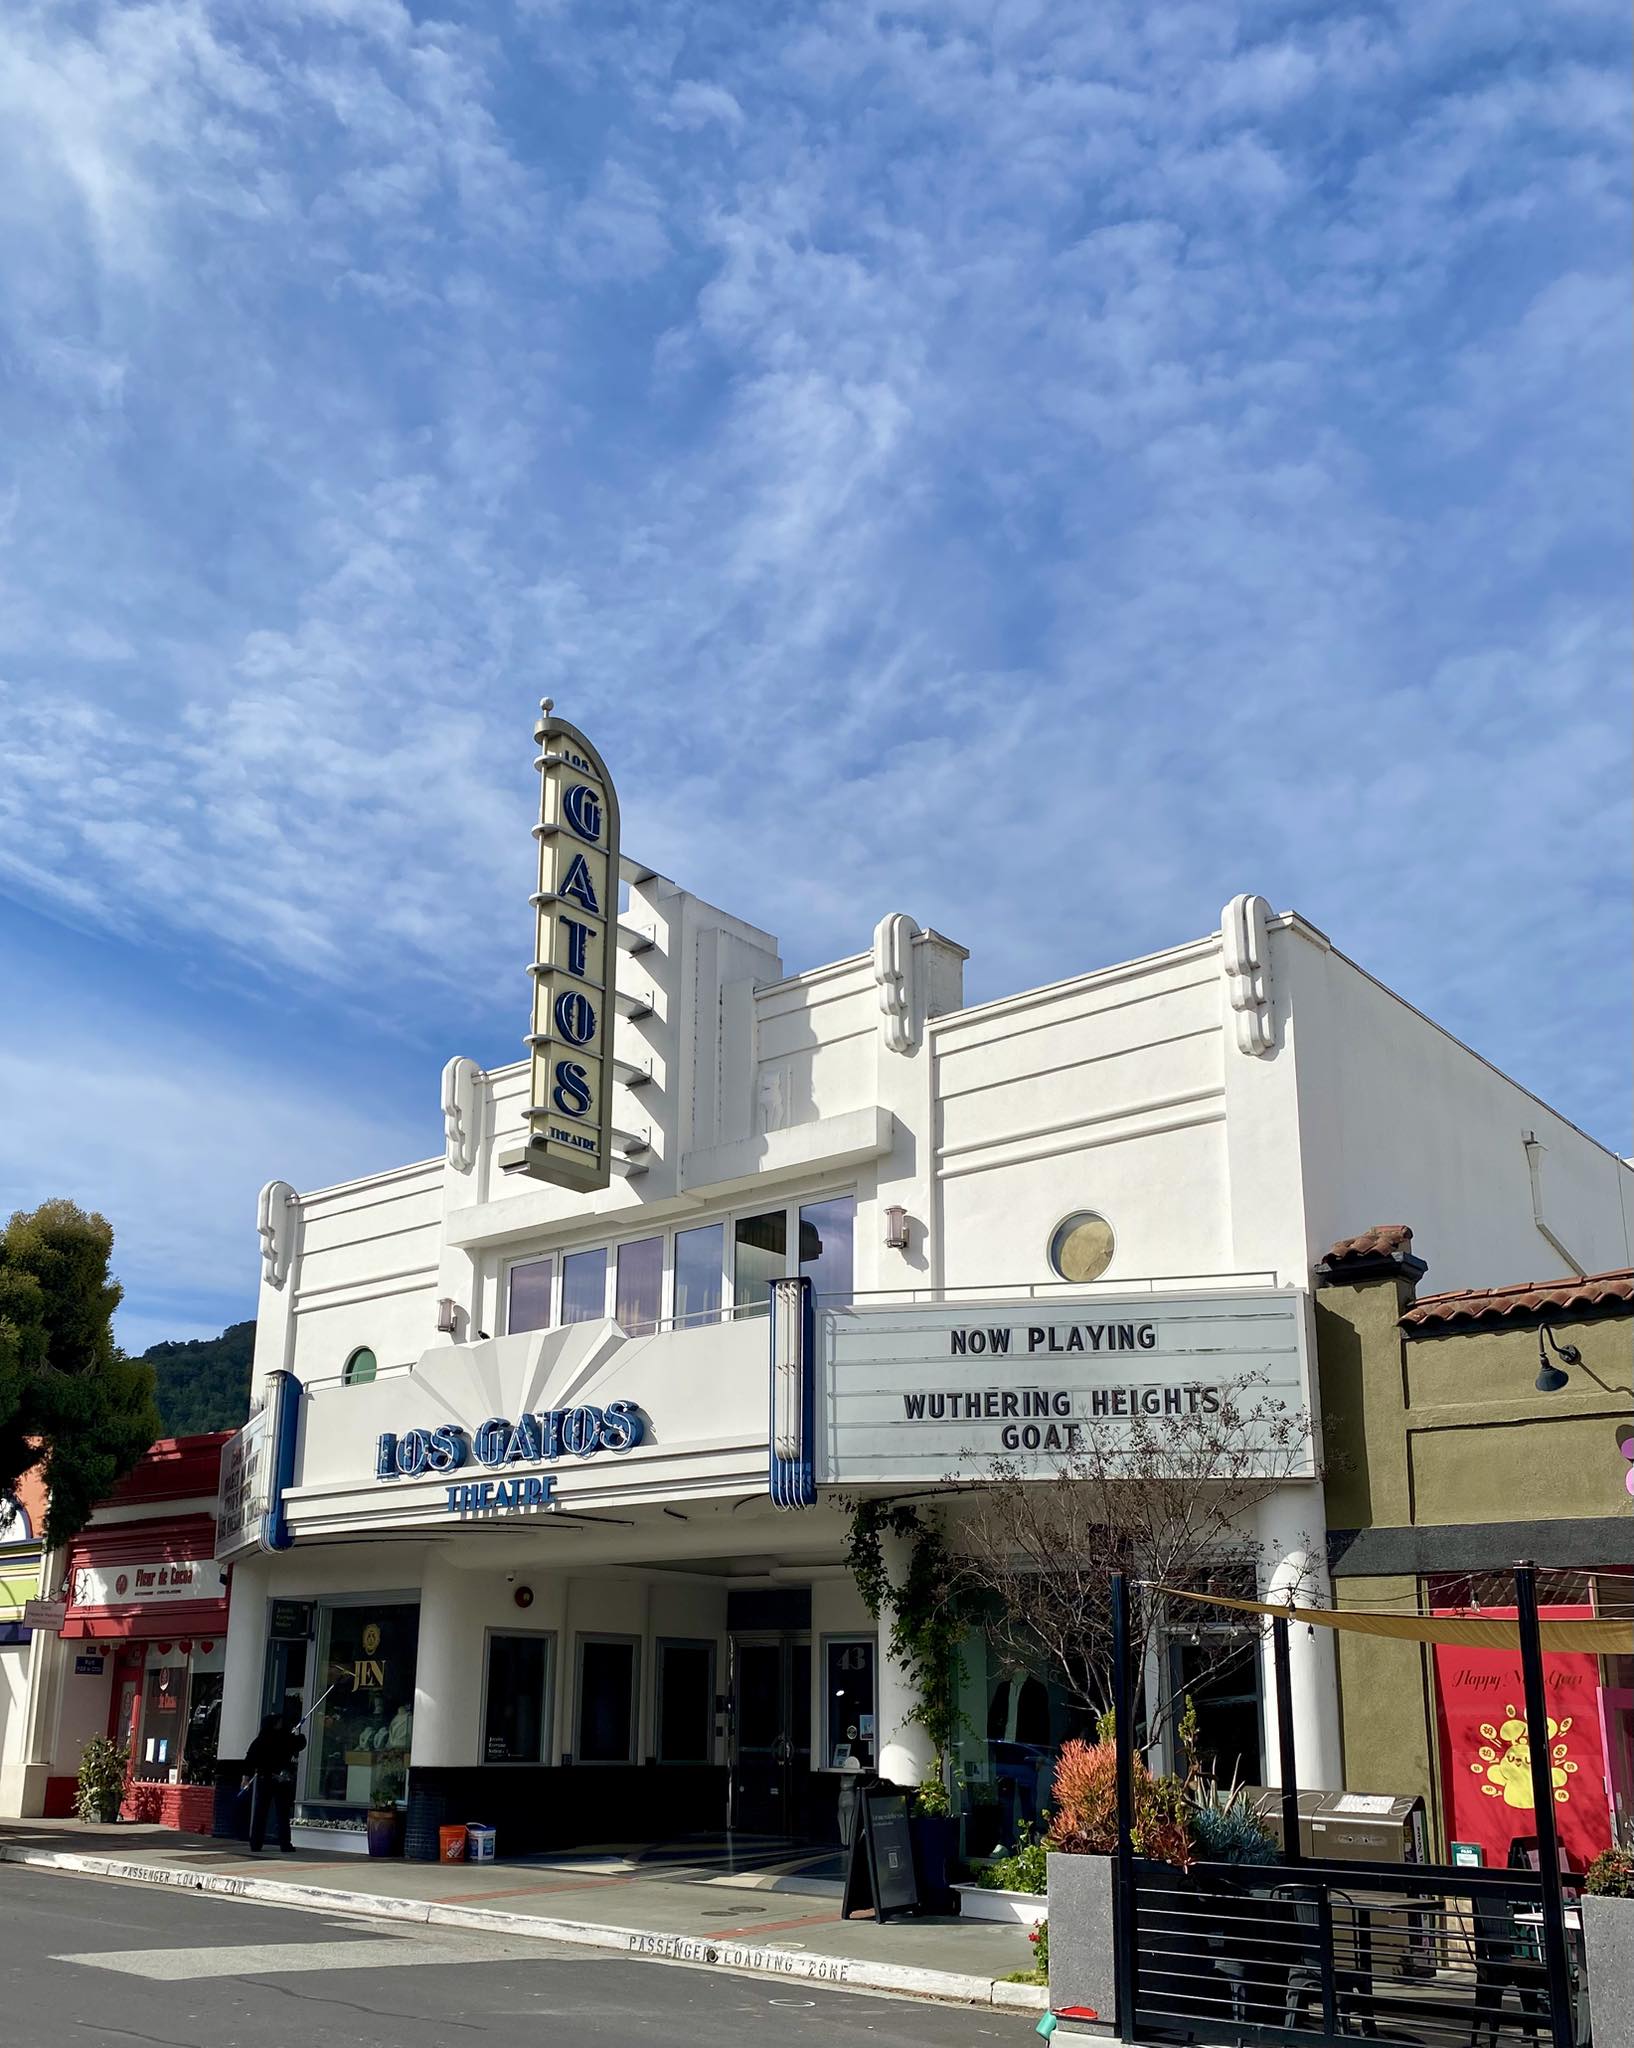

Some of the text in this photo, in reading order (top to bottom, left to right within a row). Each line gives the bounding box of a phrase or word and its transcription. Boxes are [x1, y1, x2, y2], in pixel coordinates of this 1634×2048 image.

[554, 784, 601, 1118] GATOS
[548, 1126, 597, 1152] THEATRE
[950, 1323, 1157, 1355] NOW PLAYING
[904, 1385, 1221, 1420] WUTHERING HEIGHTS
[375, 1400, 645, 1482] LOS GATOS
[1001, 1422, 1080, 1451] GOAT
[445, 1474, 558, 1513] THEATRE
[135, 1566, 193, 1588] Fleur de Cocoa
[838, 1646, 866, 1671] 43
[351, 1660, 387, 1693] JEN
[1452, 1669, 1501, 1692] Happy
[122, 1866, 171, 1883] PASSENGER
[724, 1950, 794, 1972] LOADING
[807, 1961, 849, 1982] ZONE
